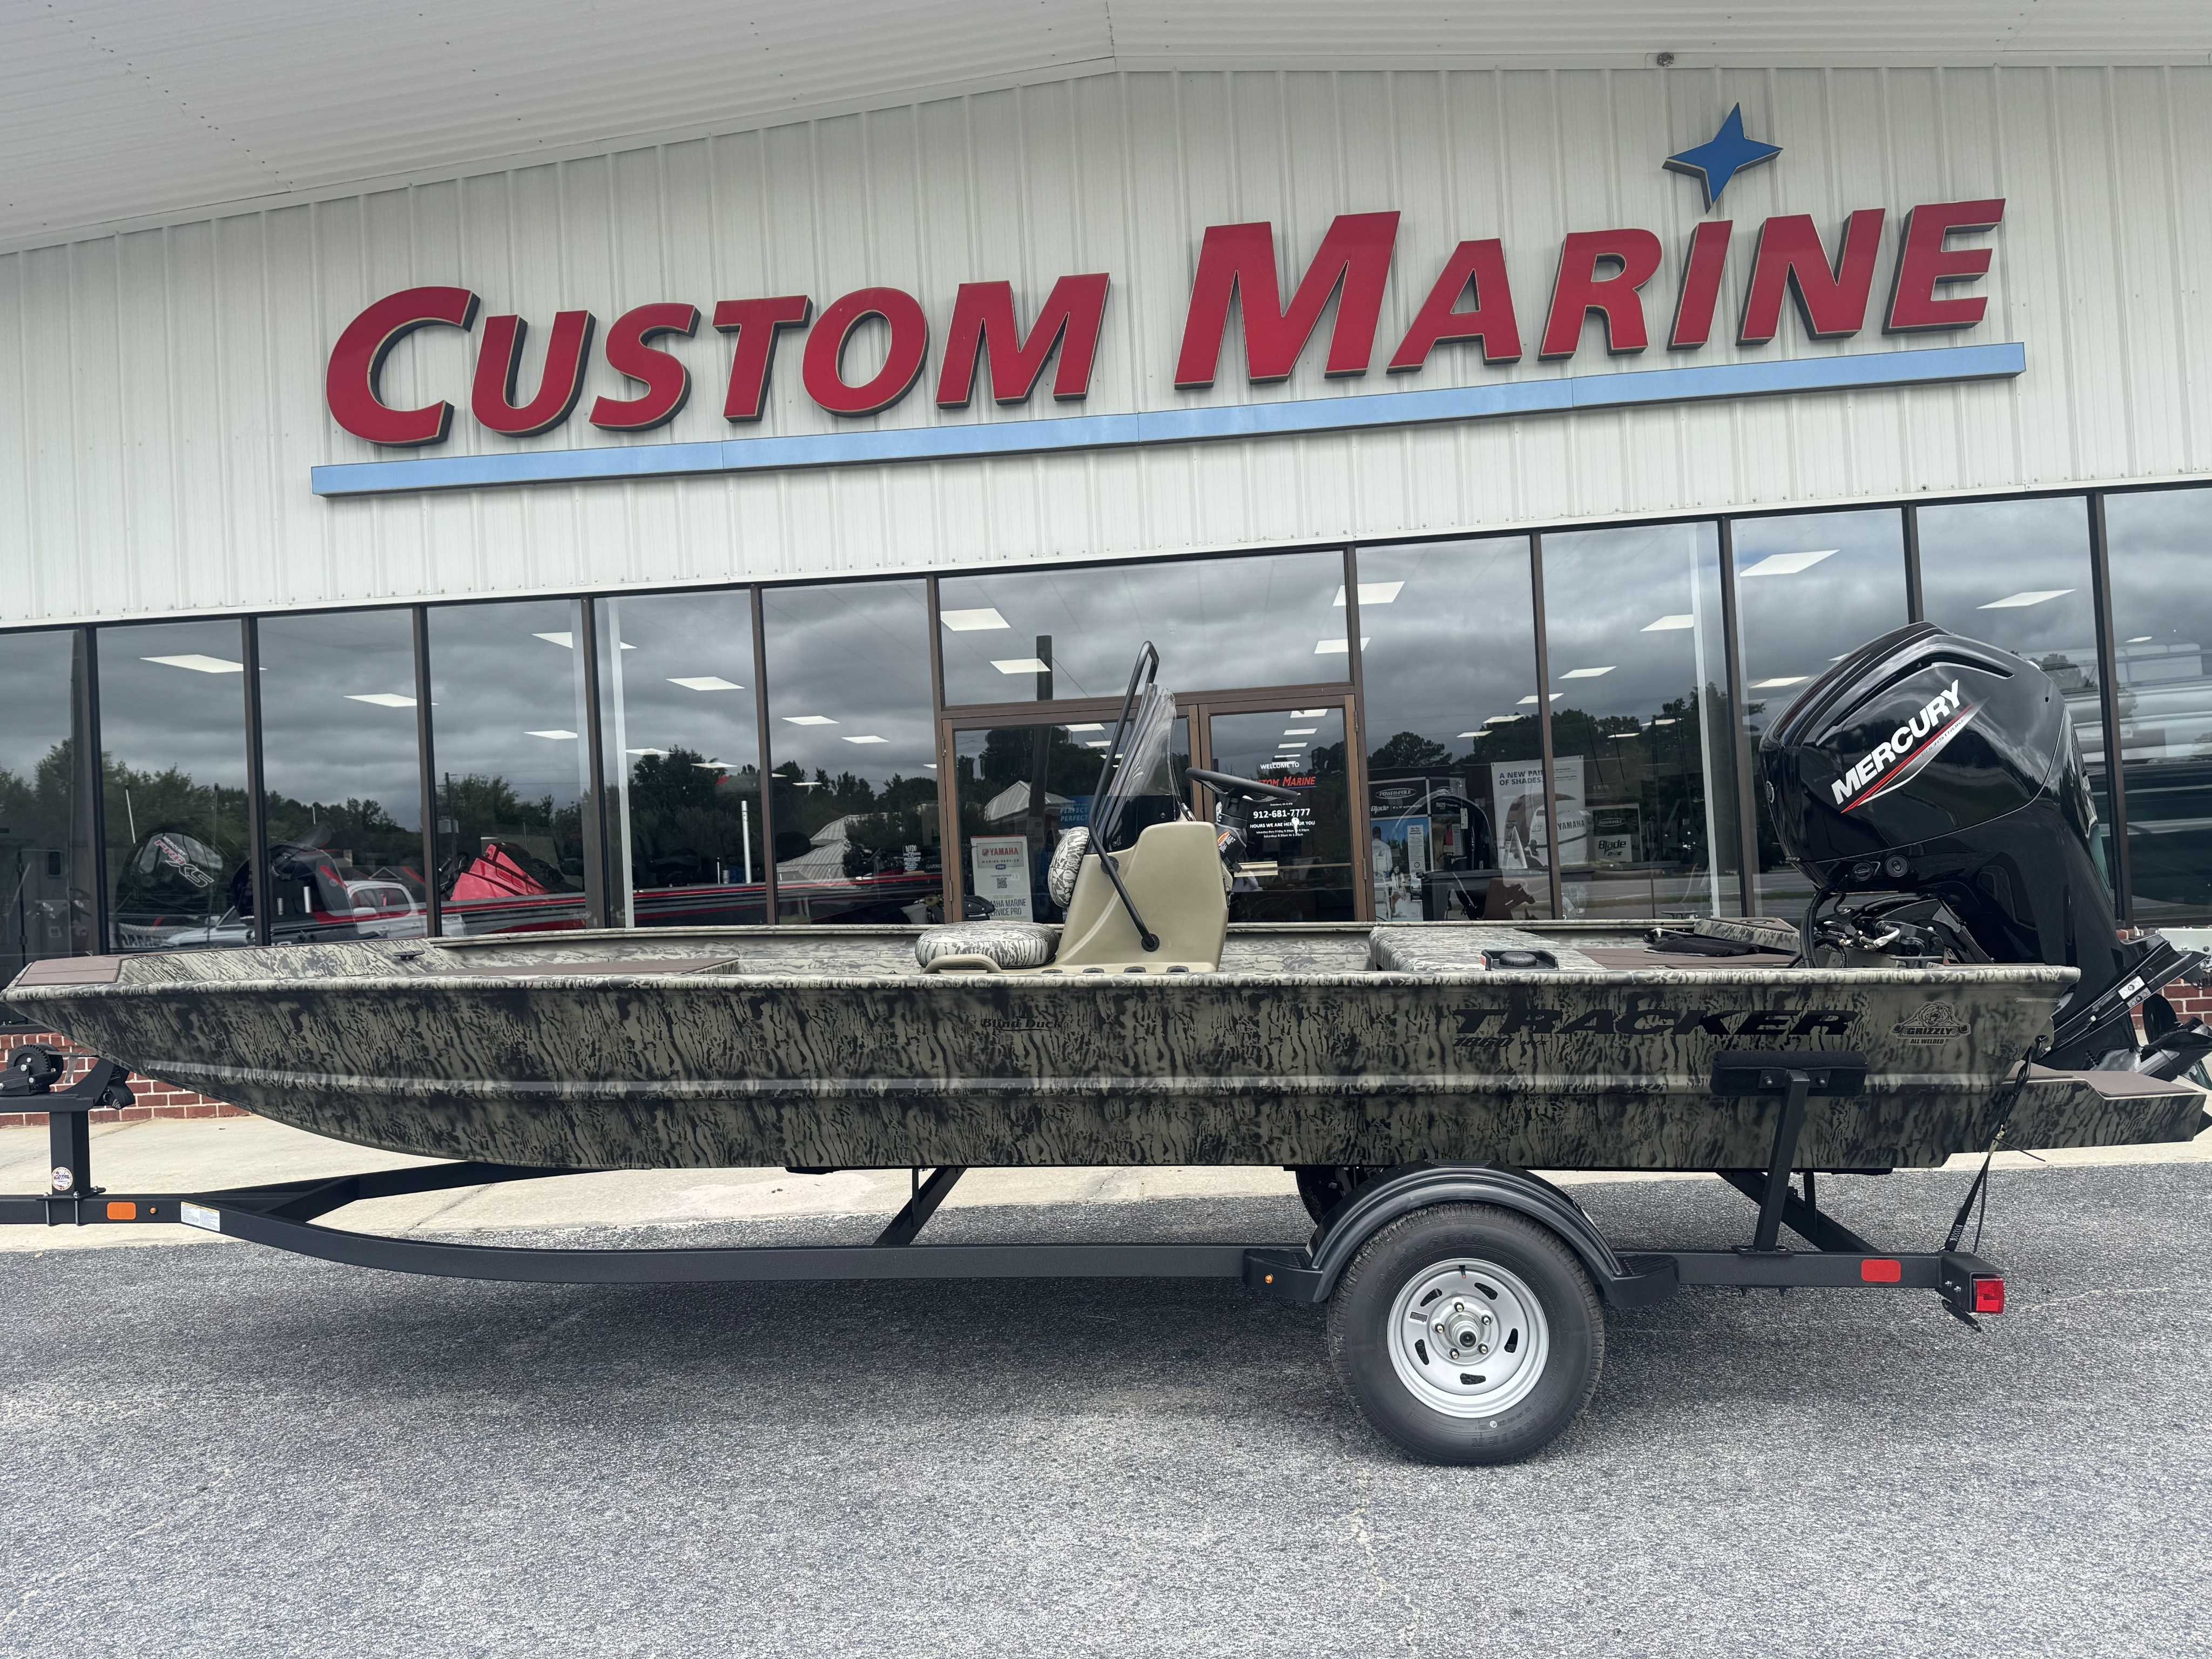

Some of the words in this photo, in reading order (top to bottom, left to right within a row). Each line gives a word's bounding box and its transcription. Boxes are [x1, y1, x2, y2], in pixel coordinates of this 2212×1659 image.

[325, 273, 1110, 448] CUSTOM
[1174, 198, 2006, 390] MARINE
[1831, 679, 1960, 805] MERCURY
[1283, 775, 1317, 787] MARINE
[1253, 808, 1310, 819] 912-681-7777
[1557, 820, 1586, 830] YAMAHA
[162, 836, 187, 855] MERCURY
[989, 847, 1019, 855] YAMAHA
[1599, 840, 1627, 855] Blade
[165, 860, 214, 887] XS
[1005, 899, 1027, 907] MARINE
[990, 908, 1009, 916] ERVICE
[1010, 907, 1022, 915] PRO
[981, 1018, 1019, 1027] Blind
[1452, 1009, 1859, 1035] TRACKER
[1453, 1037, 1515, 1047] 1860
